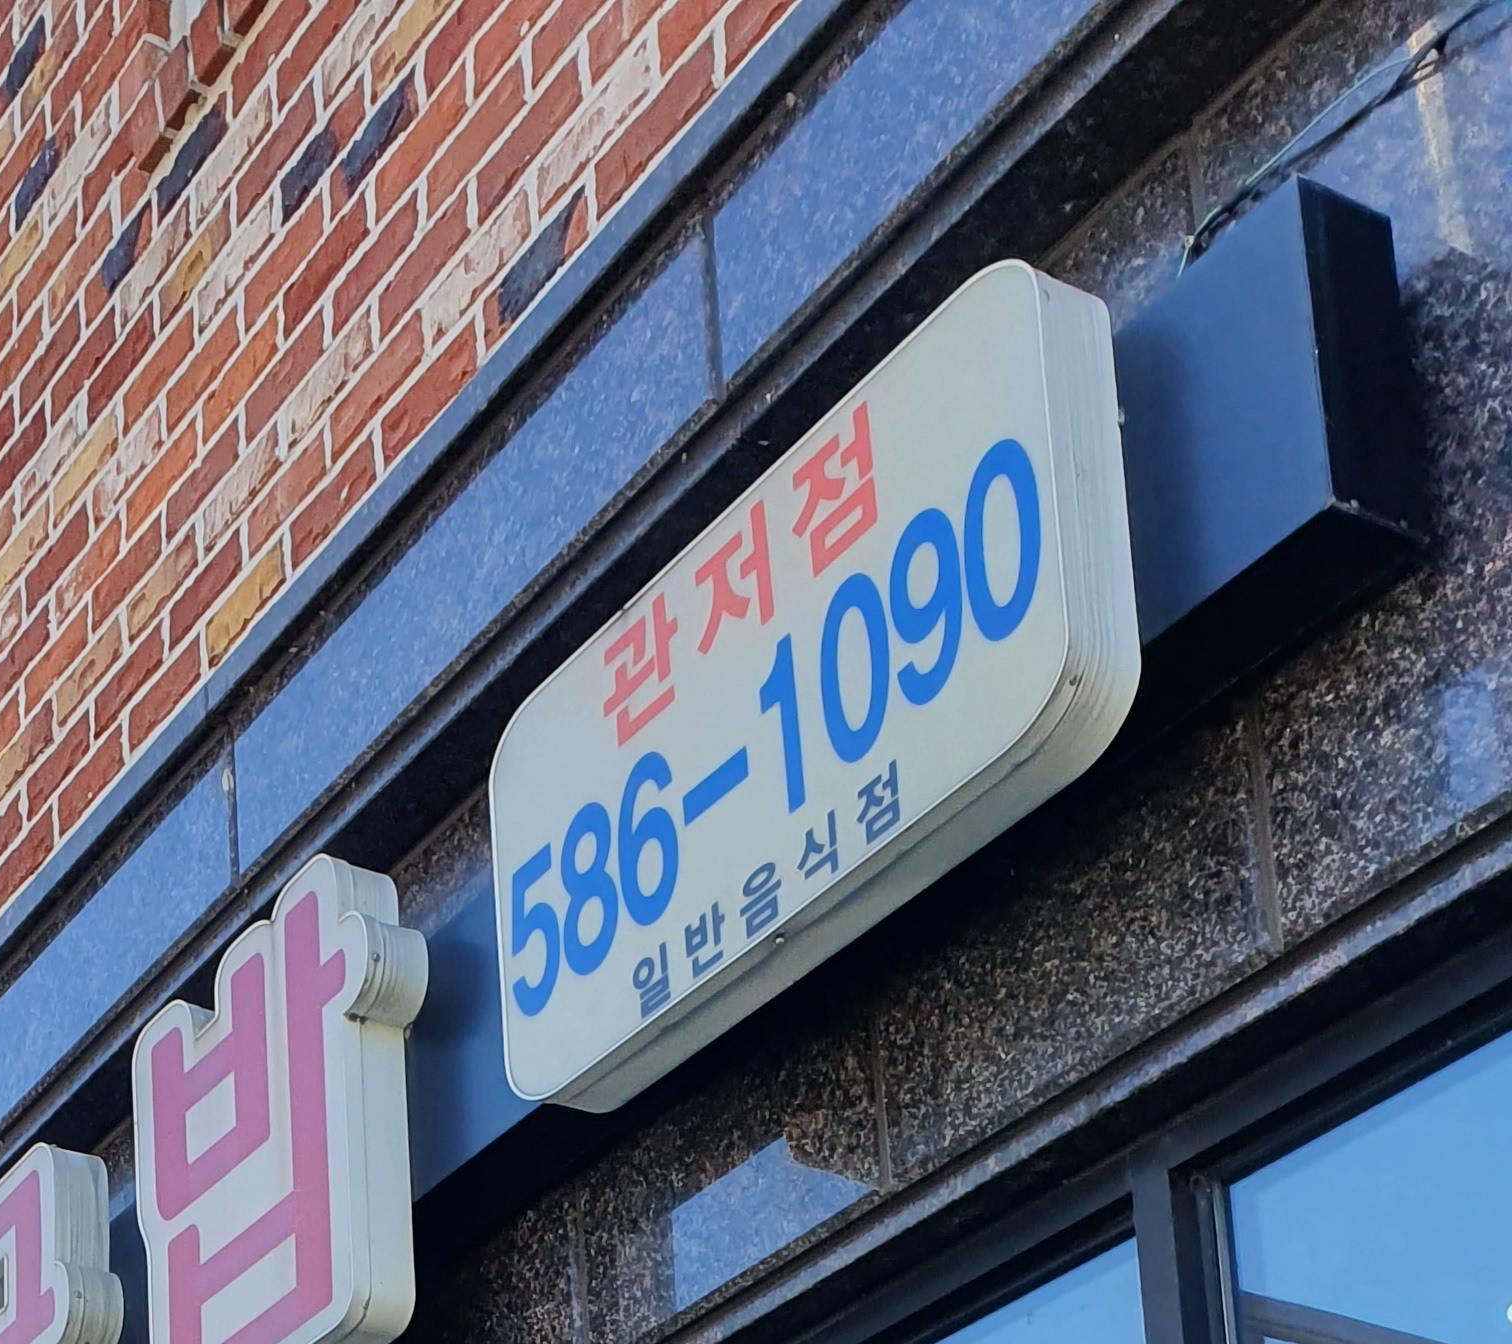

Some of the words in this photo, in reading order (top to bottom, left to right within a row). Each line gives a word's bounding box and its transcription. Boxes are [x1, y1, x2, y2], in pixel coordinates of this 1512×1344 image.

[509, 438, 1042, 1018] 586-1090
[601, 399, 880, 747] 관저점
[632, 760, 903, 1020] 일반음식점
